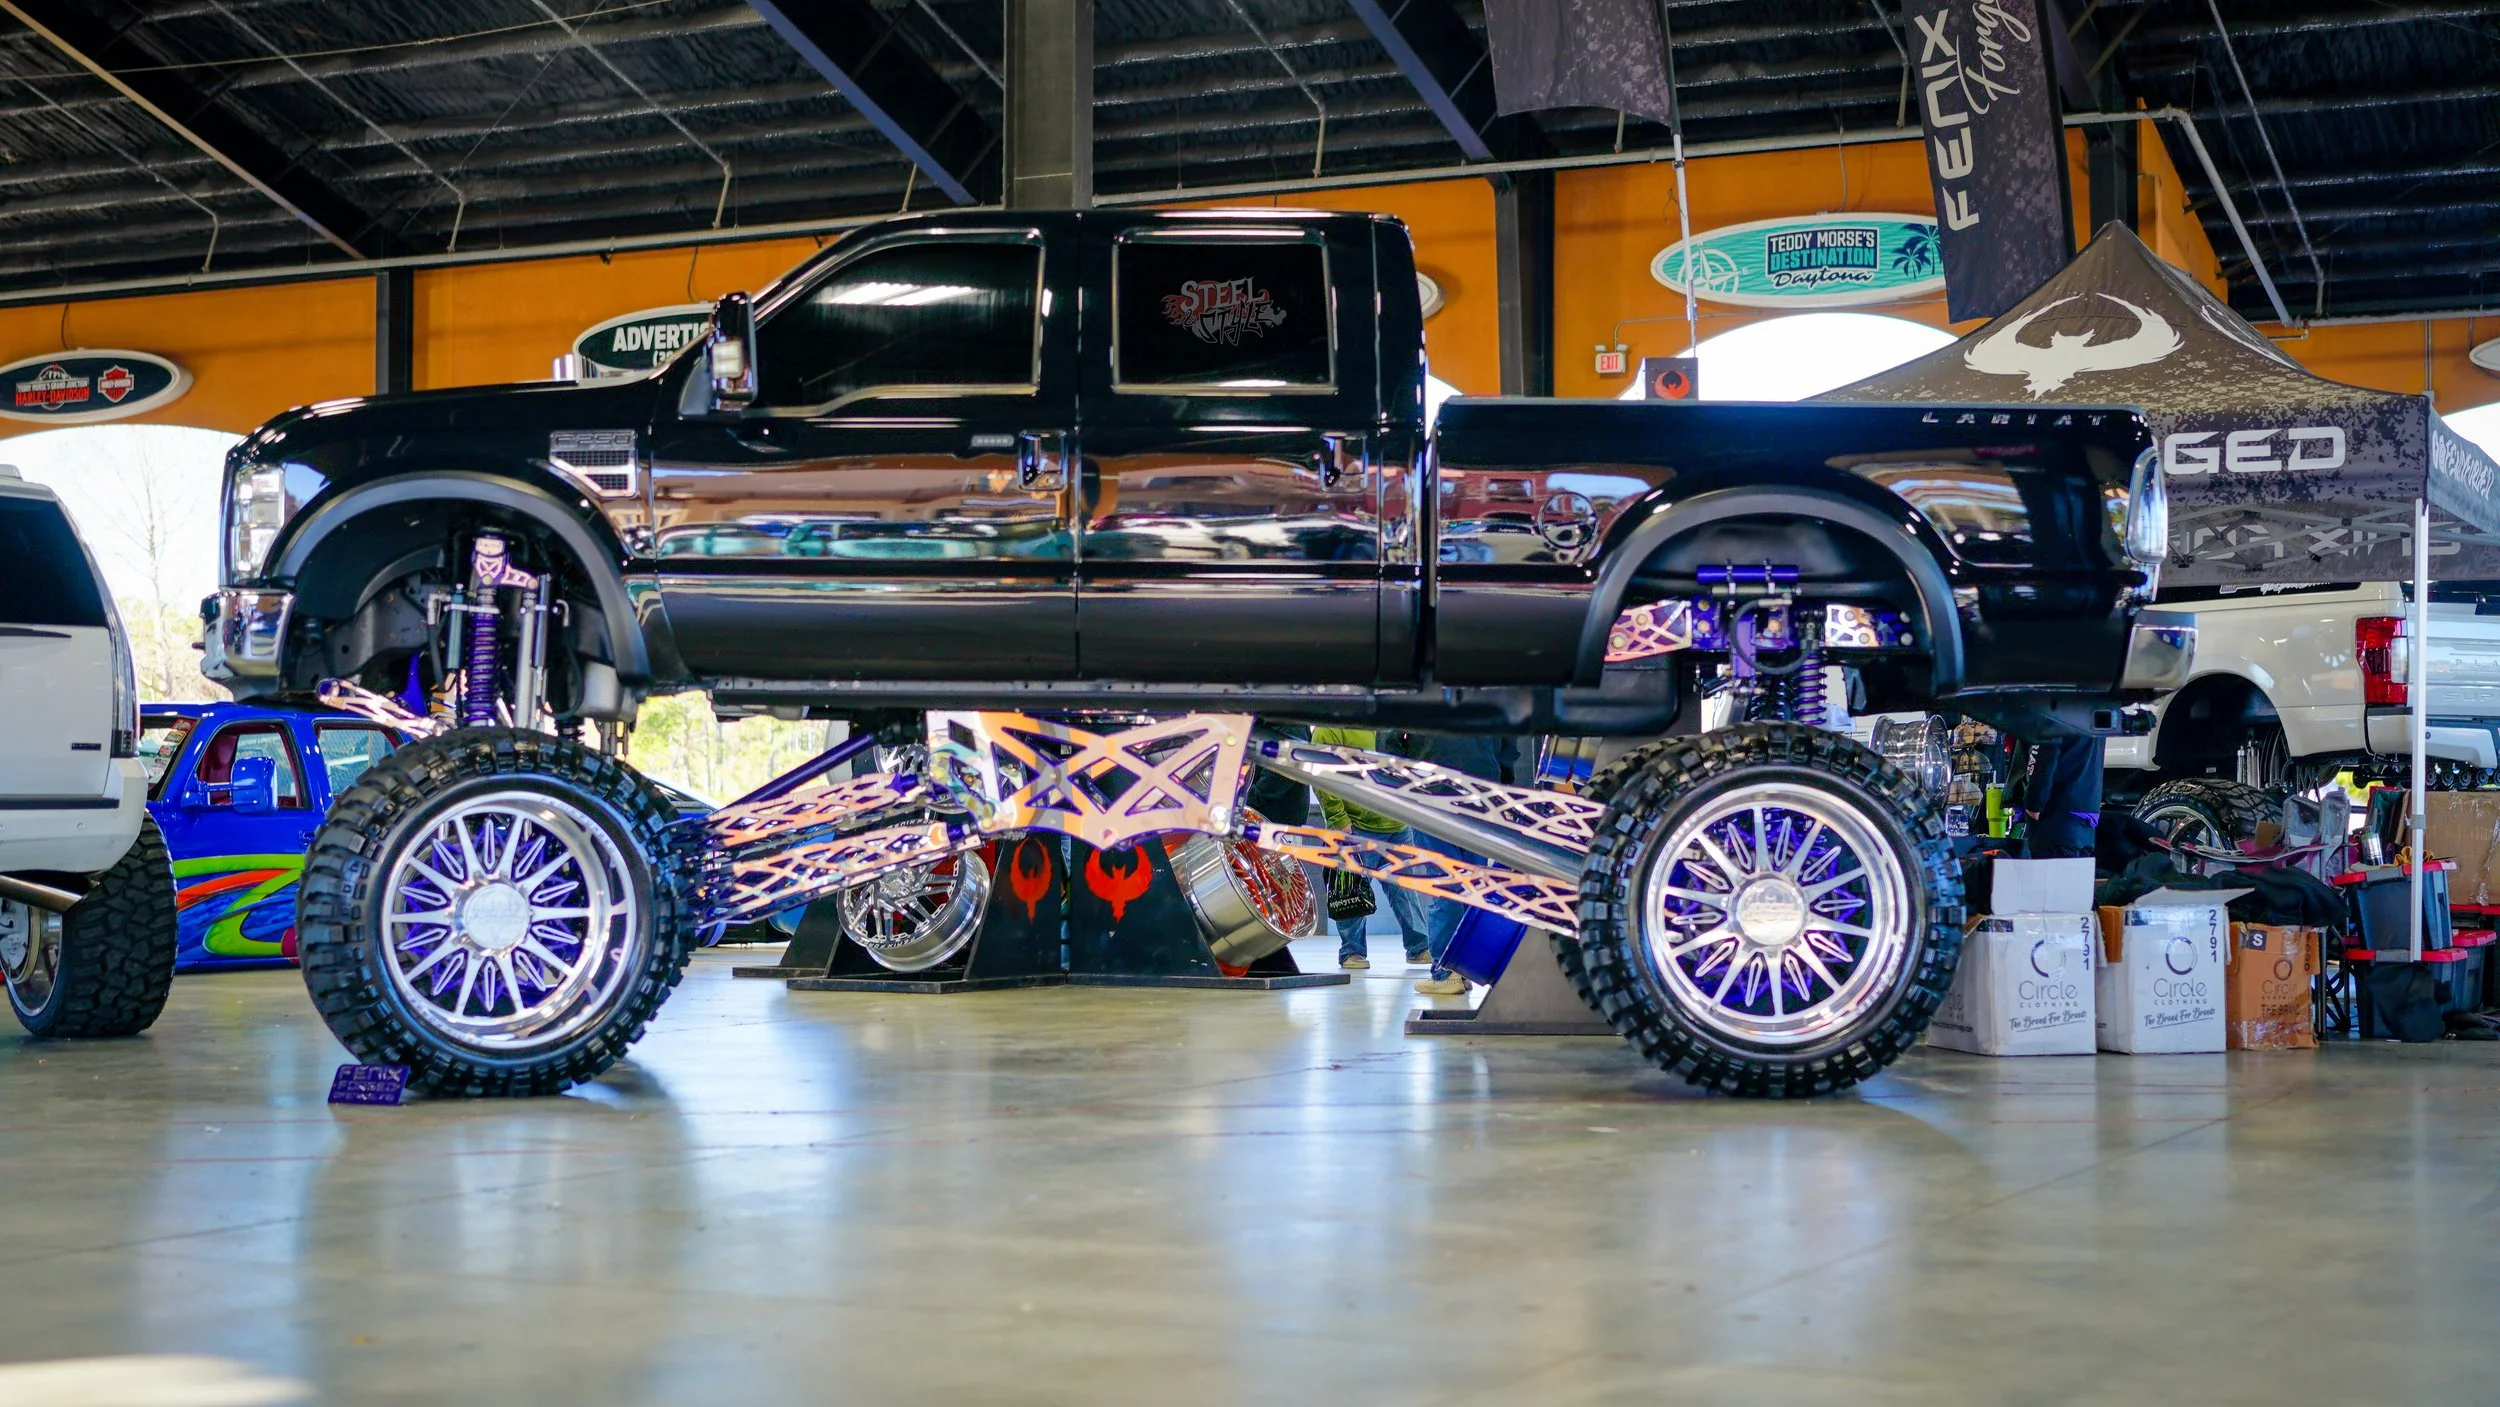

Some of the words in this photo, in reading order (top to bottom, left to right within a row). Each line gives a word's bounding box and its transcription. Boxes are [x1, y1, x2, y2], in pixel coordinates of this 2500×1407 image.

[1956, 0, 2031, 115] Forg
[1914, 9, 1980, 232] FENIX
[1769, 232, 1812, 253] TEDDY
[1817, 230, 1875, 248] MORSE'S
[1770, 247, 1874, 273] DESTINATION
[1773, 267, 1873, 288] Daytona
[1180, 276, 1265, 314] STEEL
[1184, 309, 1196, 327] &
[1199, 300, 1274, 346] STYLE
[1600, 354, 1619, 370] EXIT
[16, 386, 91, 407] HARLEY-DAVIDSON
[1921, 411, 2107, 426] LARIAT
[2152, 426, 2346, 475] GED
[1329, 896, 1361, 909] MONSTER
[2208, 909, 2218, 963] 2791
[2252, 933, 2263, 947] S
[2019, 980, 2078, 1001] Circle
[2153, 977, 2208, 998] Circle
[2019, 1001, 2078, 1009] CLOTHING
[2009, 1017, 2021, 1030] The
[2047, 1011, 2061, 1024] For
[2144, 1015, 2155, 1027] The
[2179, 1009, 2192, 1022] For
[337, 1065, 403, 1083] FENIX
